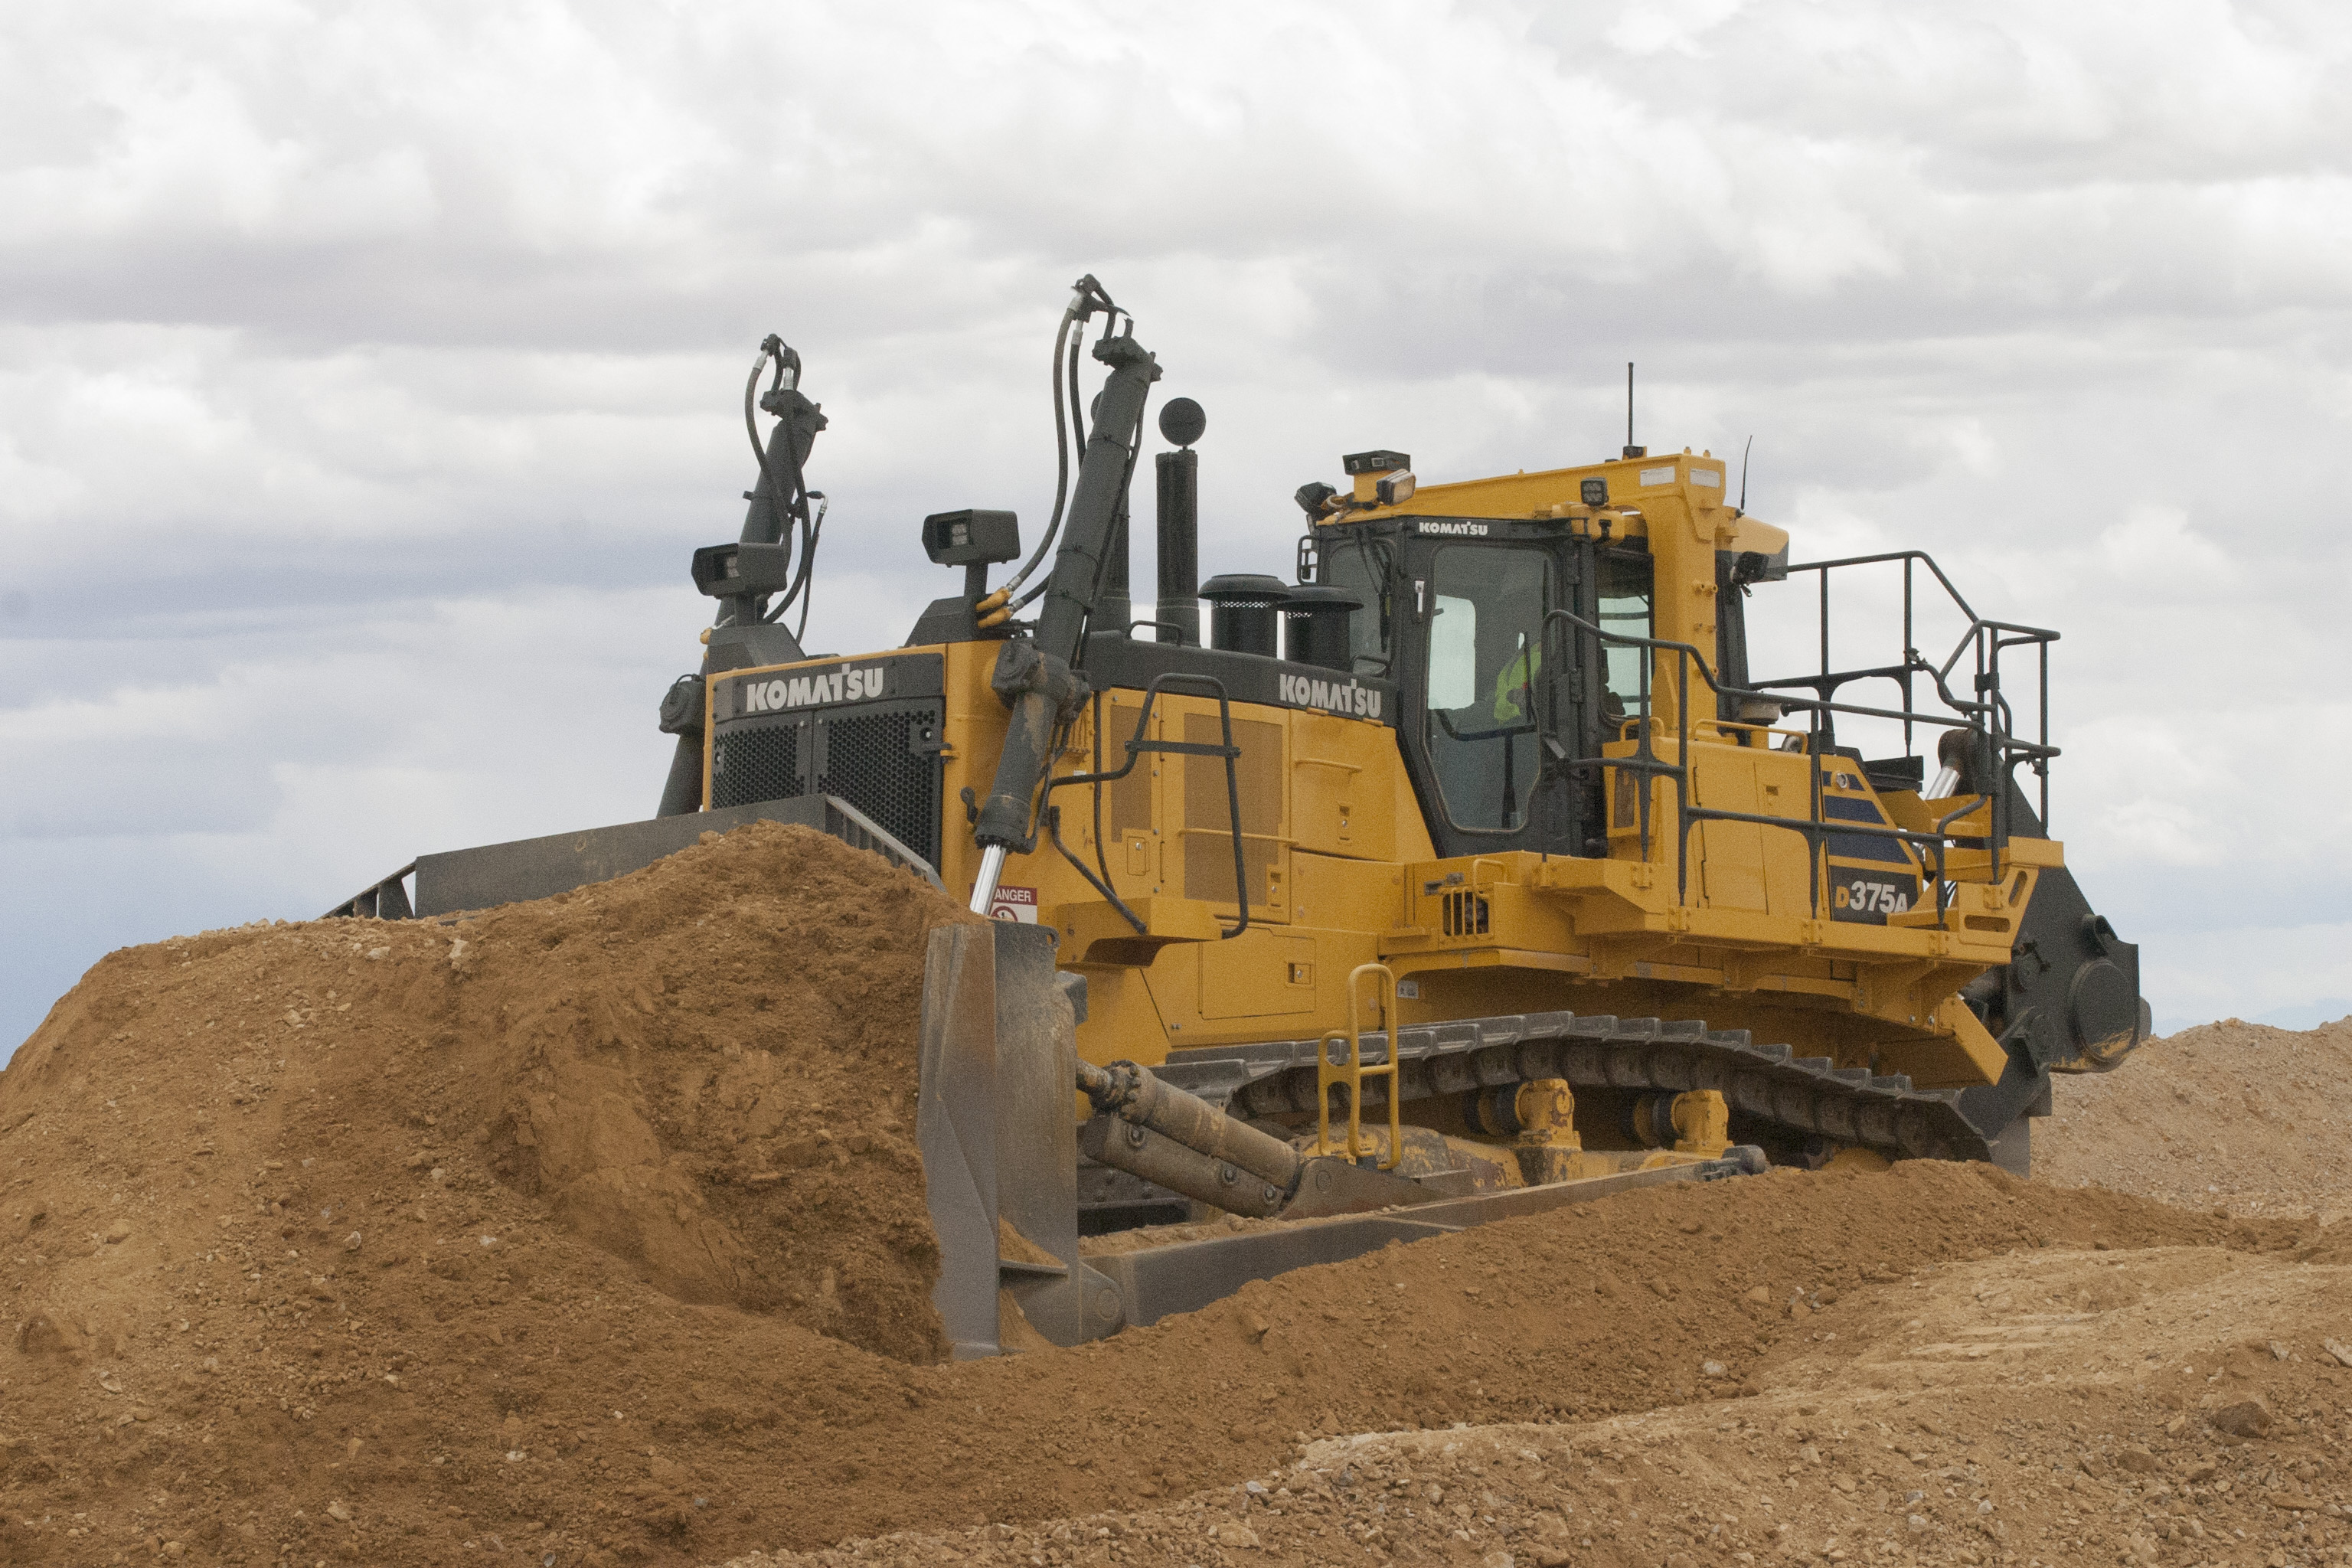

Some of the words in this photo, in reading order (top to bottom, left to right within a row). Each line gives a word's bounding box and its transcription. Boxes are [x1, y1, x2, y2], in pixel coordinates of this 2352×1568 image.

[1419, 521, 1488, 535] KOMATSU
[746, 664, 884, 712] KOMATSU
[1279, 674, 1381, 718] KOMATSU
[995, 888, 1031, 903] ANGER
[1835, 880, 1908, 913] D375A
